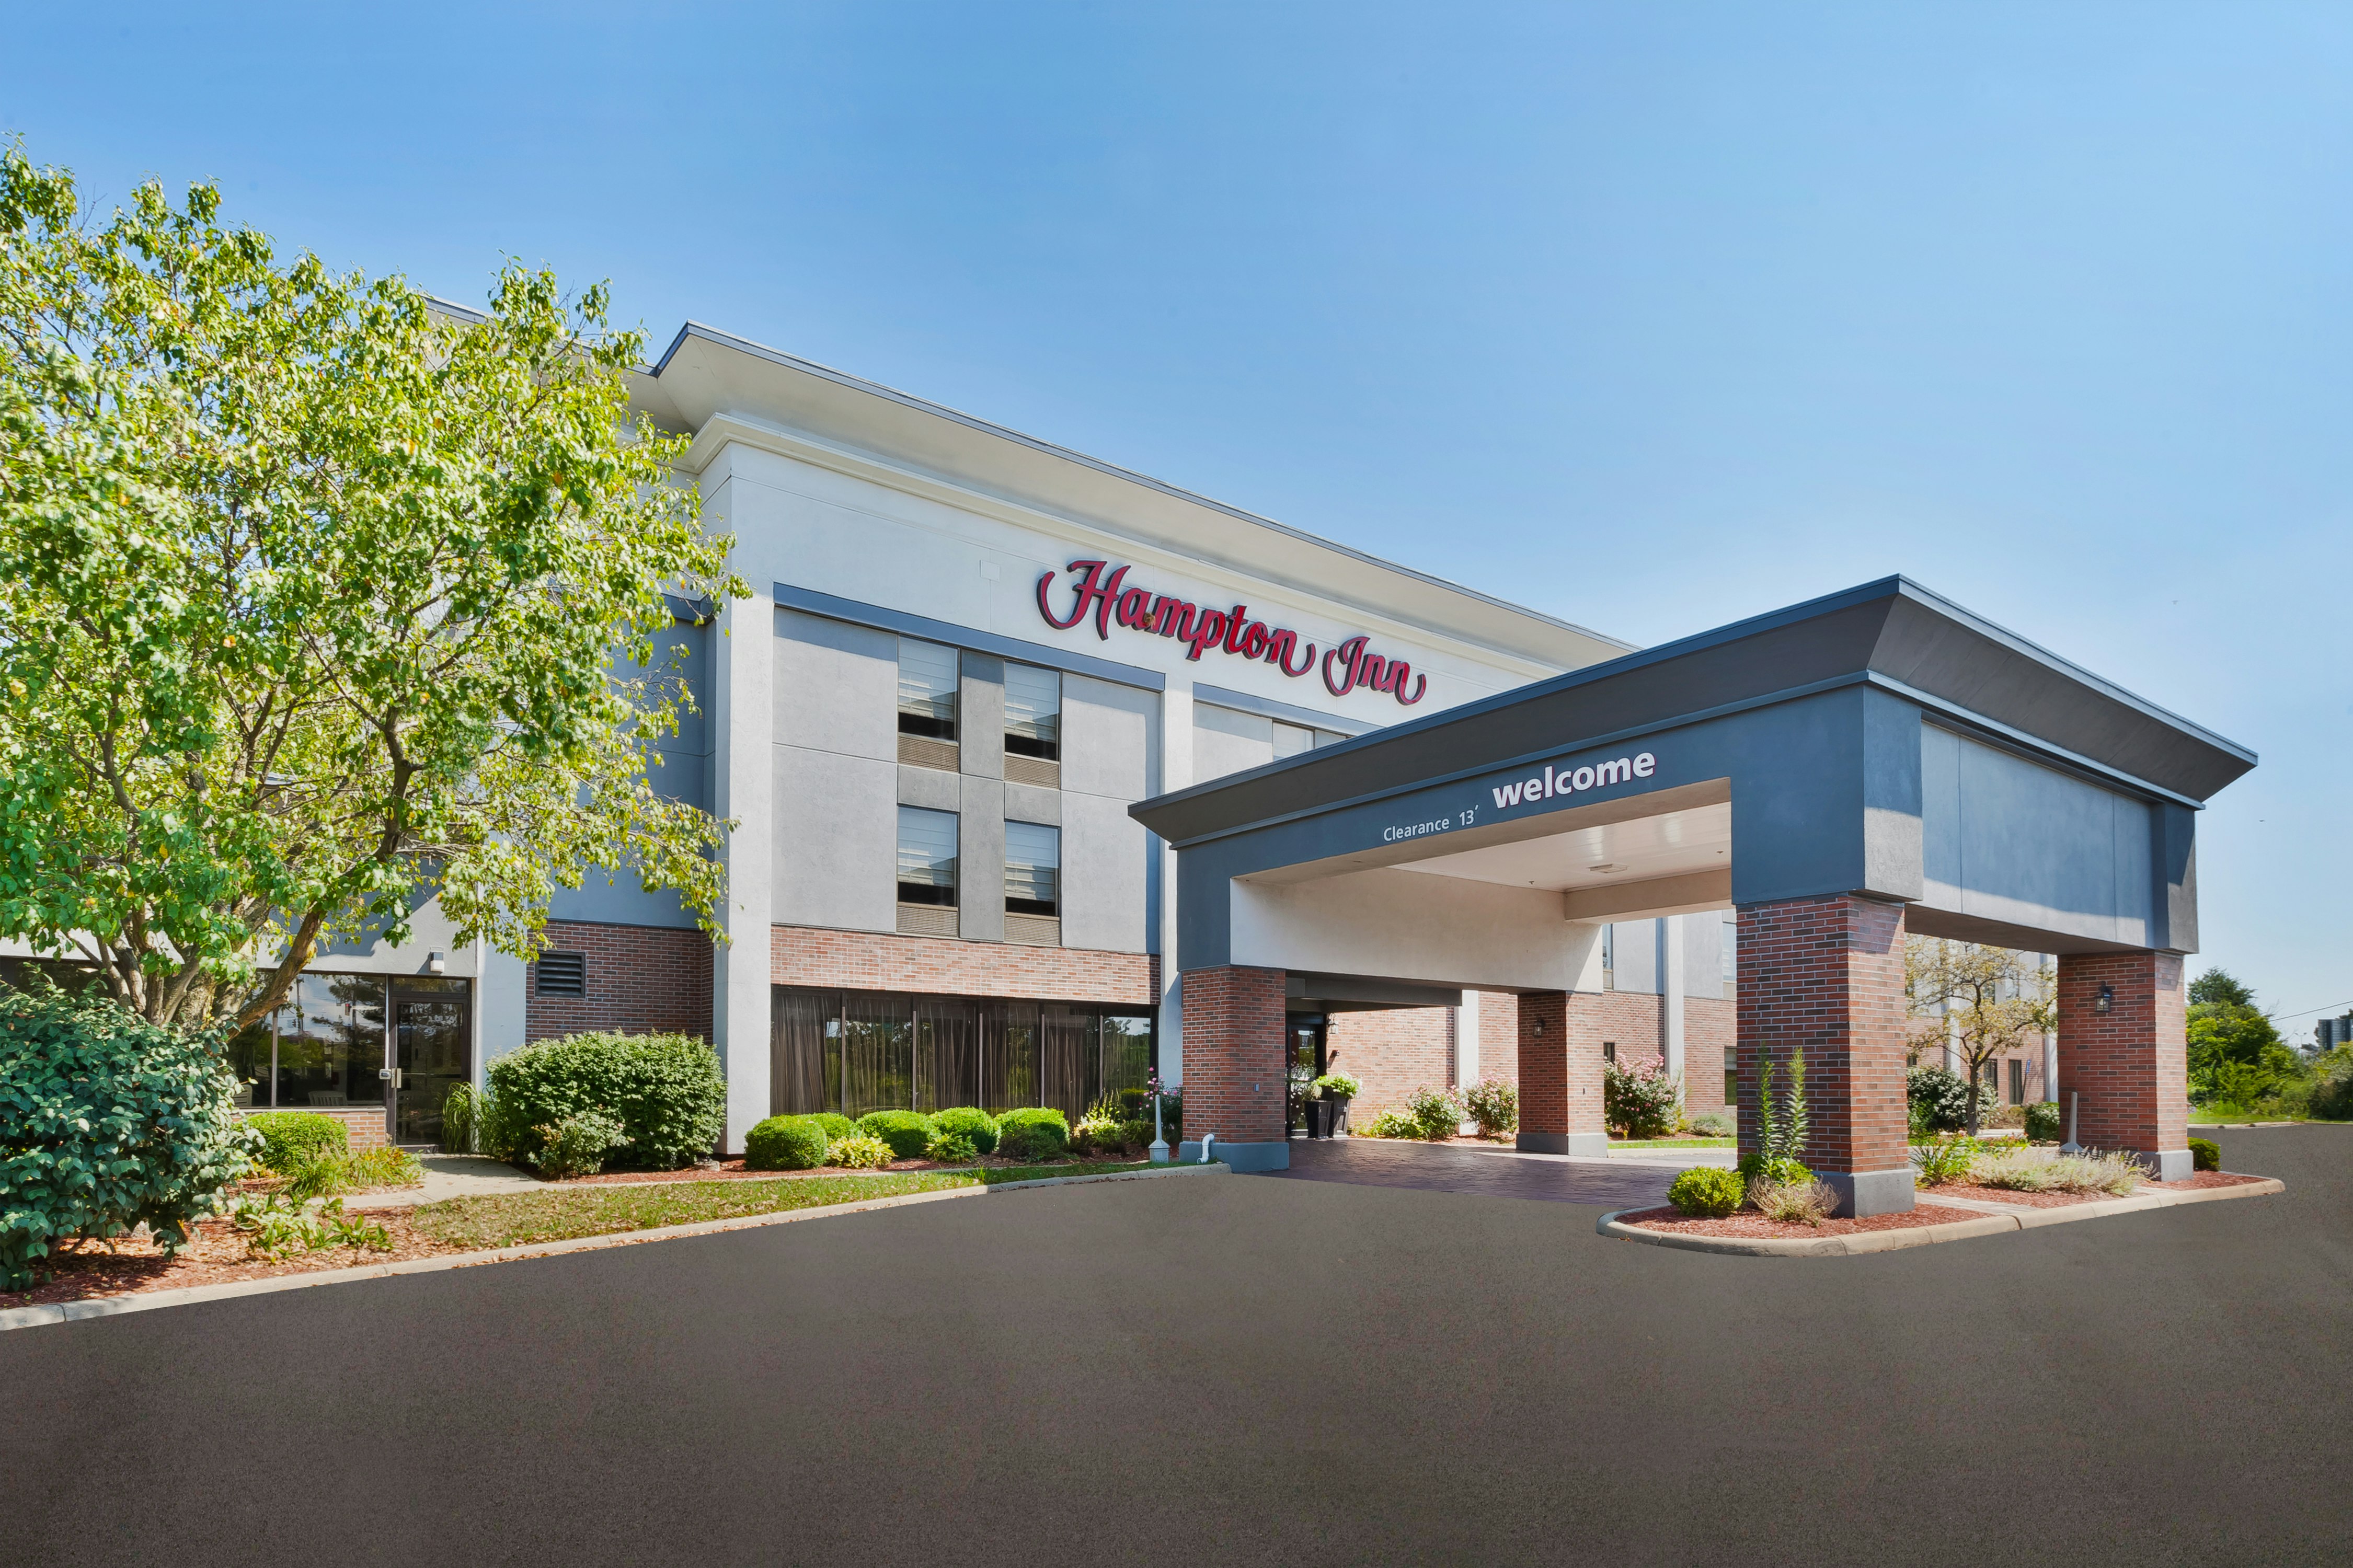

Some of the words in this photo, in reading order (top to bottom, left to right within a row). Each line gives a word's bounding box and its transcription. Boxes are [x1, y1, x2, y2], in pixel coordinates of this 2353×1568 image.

[1037, 560, 1316, 677] Hampton
[1322, 636, 1427, 706] Inn
[1492, 752, 1656, 809] welcome
[1383, 816, 1450, 841] Clearance
